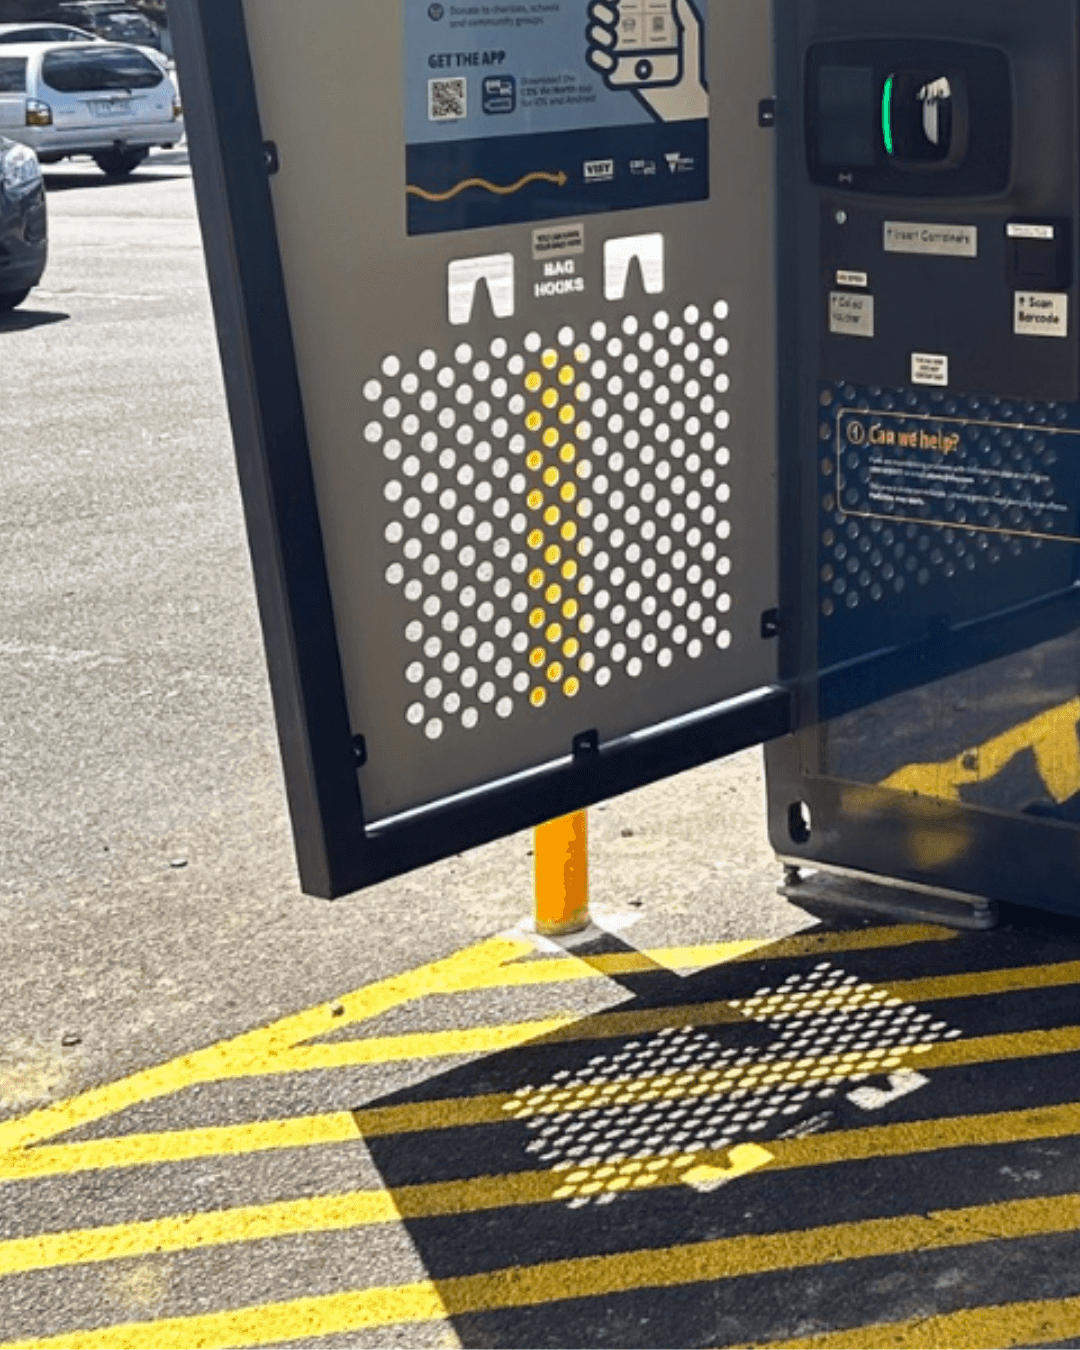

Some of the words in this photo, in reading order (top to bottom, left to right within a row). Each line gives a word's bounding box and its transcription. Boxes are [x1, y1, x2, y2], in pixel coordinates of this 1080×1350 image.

[428, 53, 451, 68] GET
[455, 52, 478, 67] THE
[482, 50, 506, 66] APP
[544, 260, 575, 276] BAG
[534, 277, 584, 298] HOOKS
[869, 424, 894, 445] Can
[899, 430, 916, 446] we
[920, 427, 959, 454] help?
